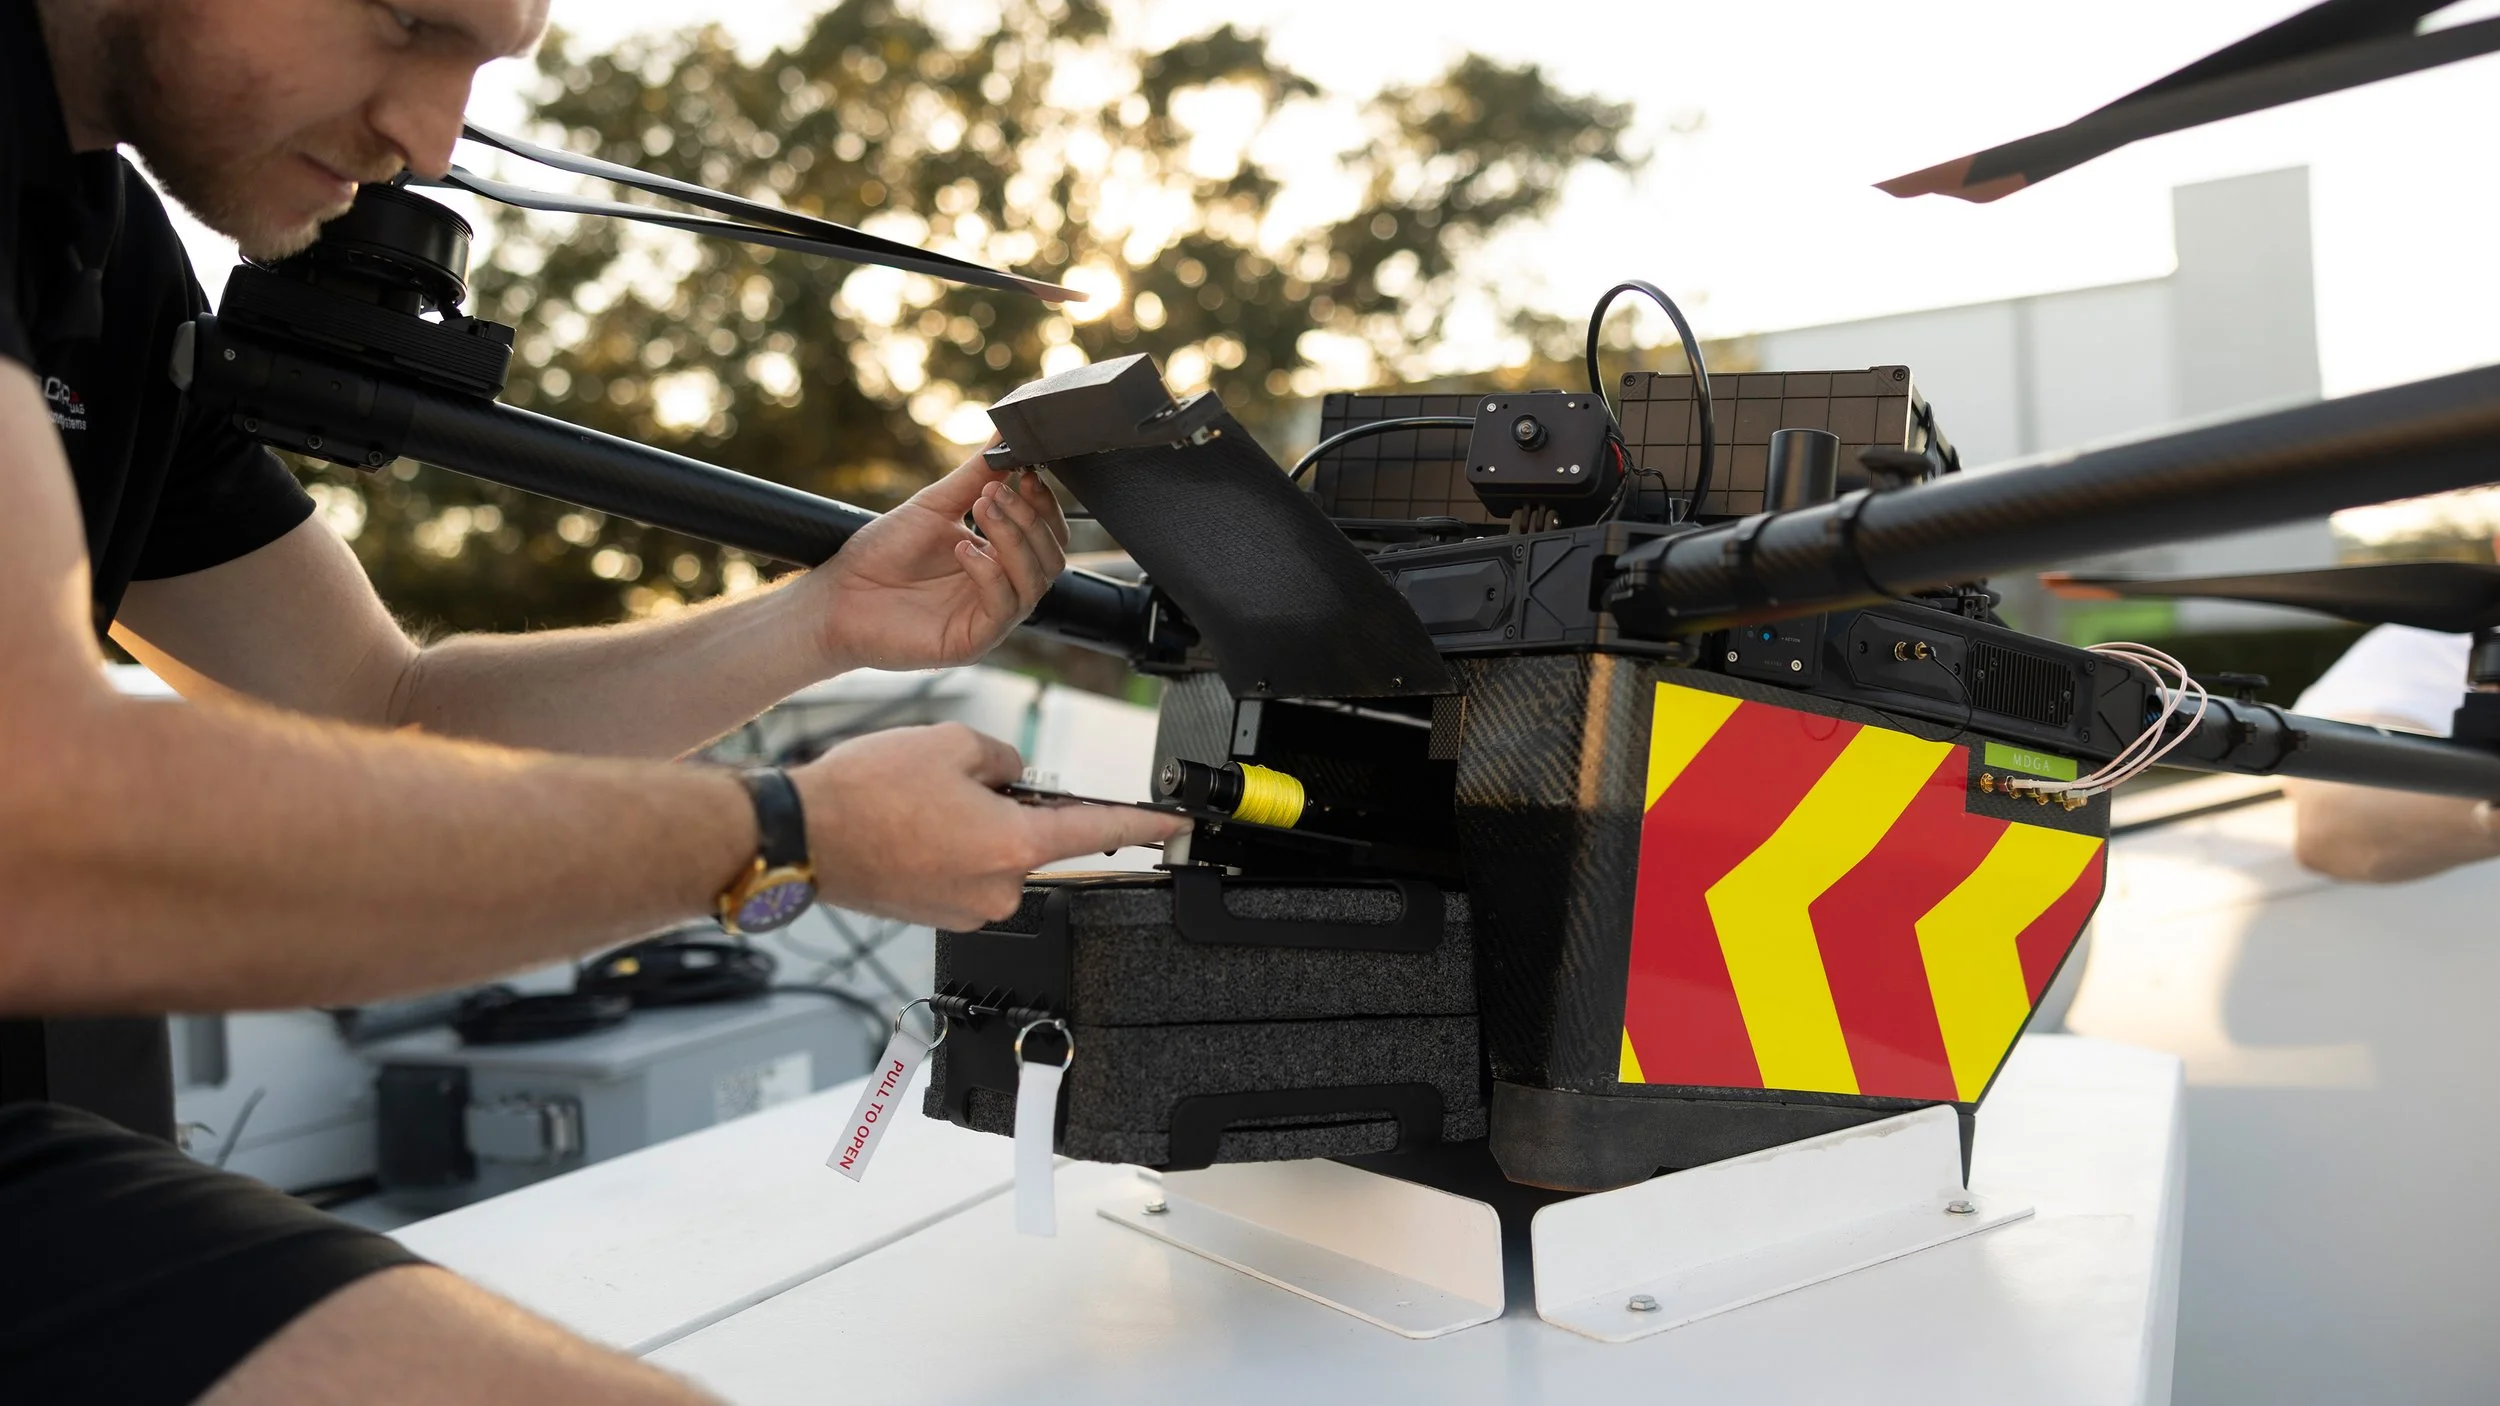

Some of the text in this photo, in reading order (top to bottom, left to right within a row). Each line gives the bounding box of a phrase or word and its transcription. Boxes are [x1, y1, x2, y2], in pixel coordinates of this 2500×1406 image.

[2013, 753, 2050, 772] MDGA
[839, 1060, 905, 1170] PULL TO OPEN
